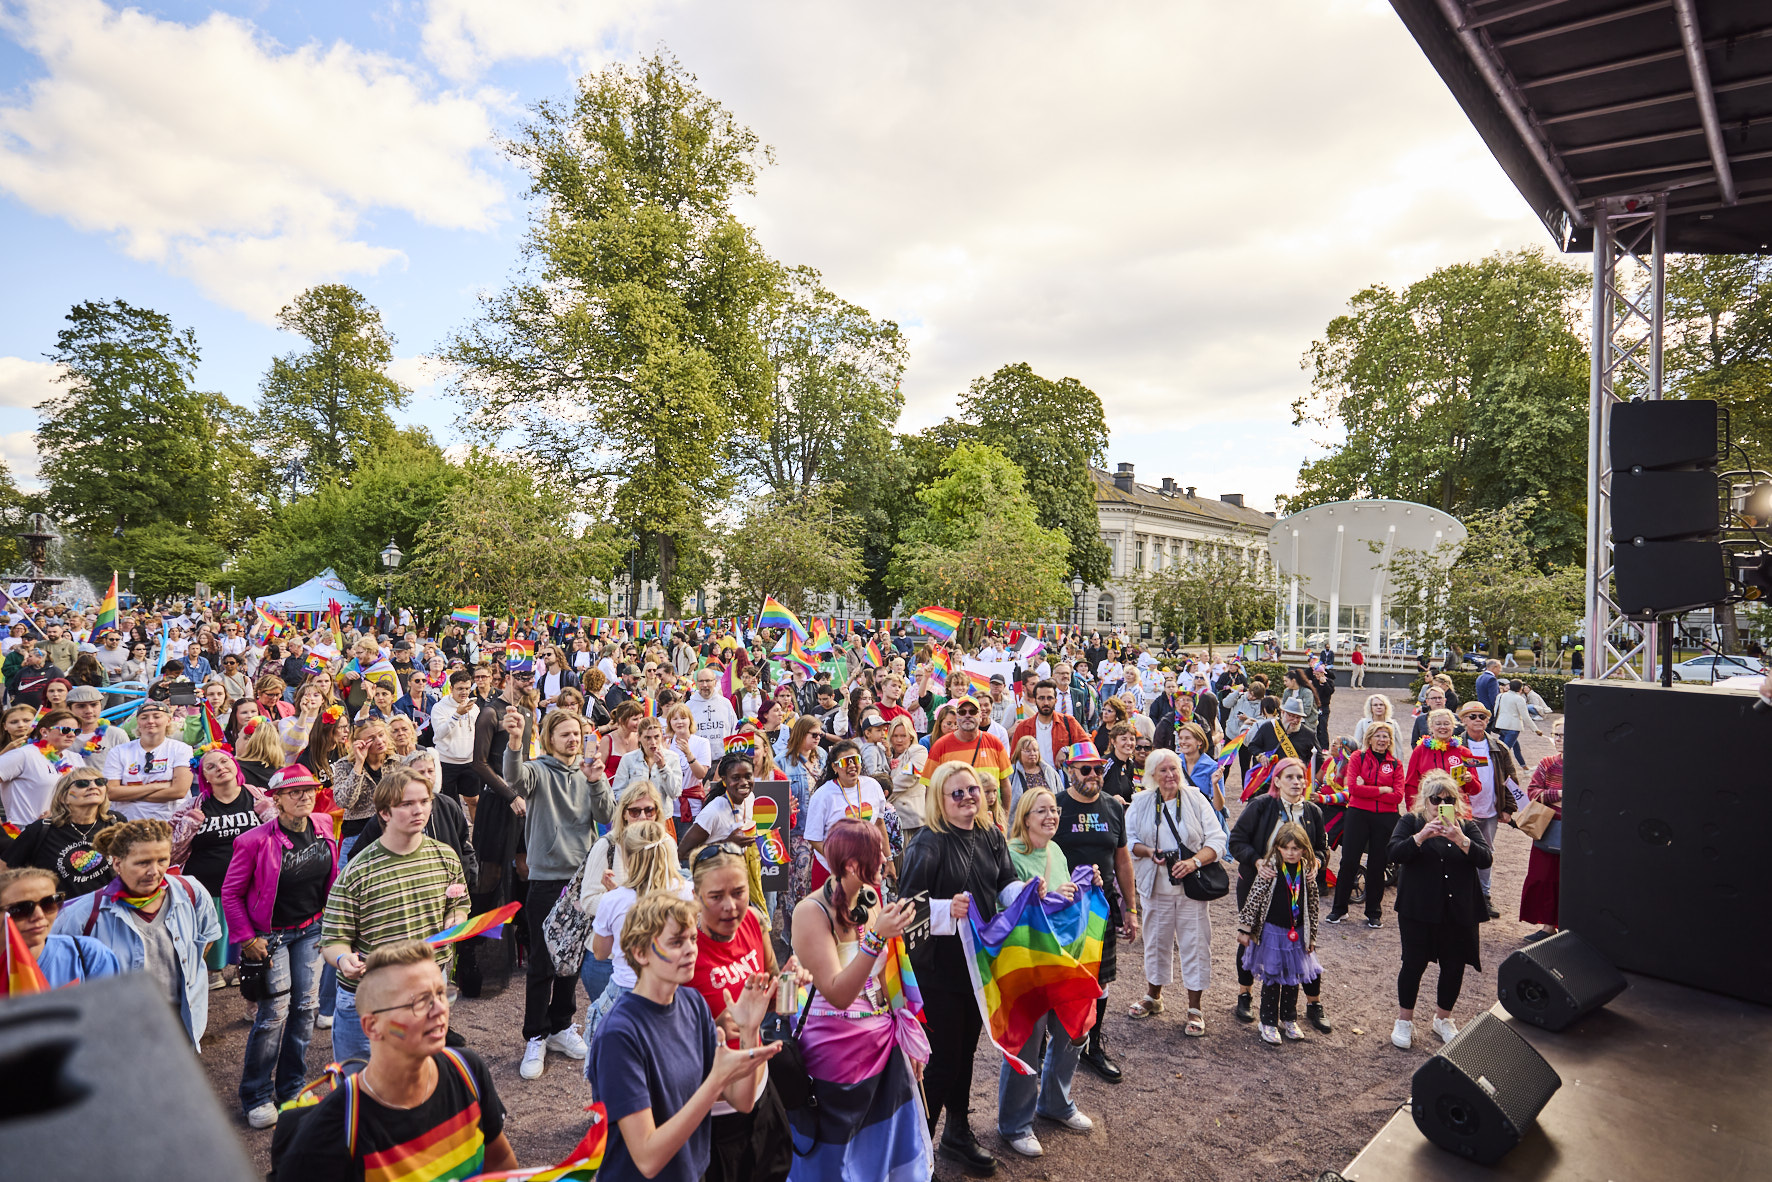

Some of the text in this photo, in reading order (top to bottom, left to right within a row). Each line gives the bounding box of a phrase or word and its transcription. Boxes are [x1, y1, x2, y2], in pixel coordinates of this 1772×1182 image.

[1078, 813, 1100, 824] GAY
[218, 828, 241, 838] 1970
[1071, 824, 1084, 833] AS
[710, 948, 760, 989] CUNT
